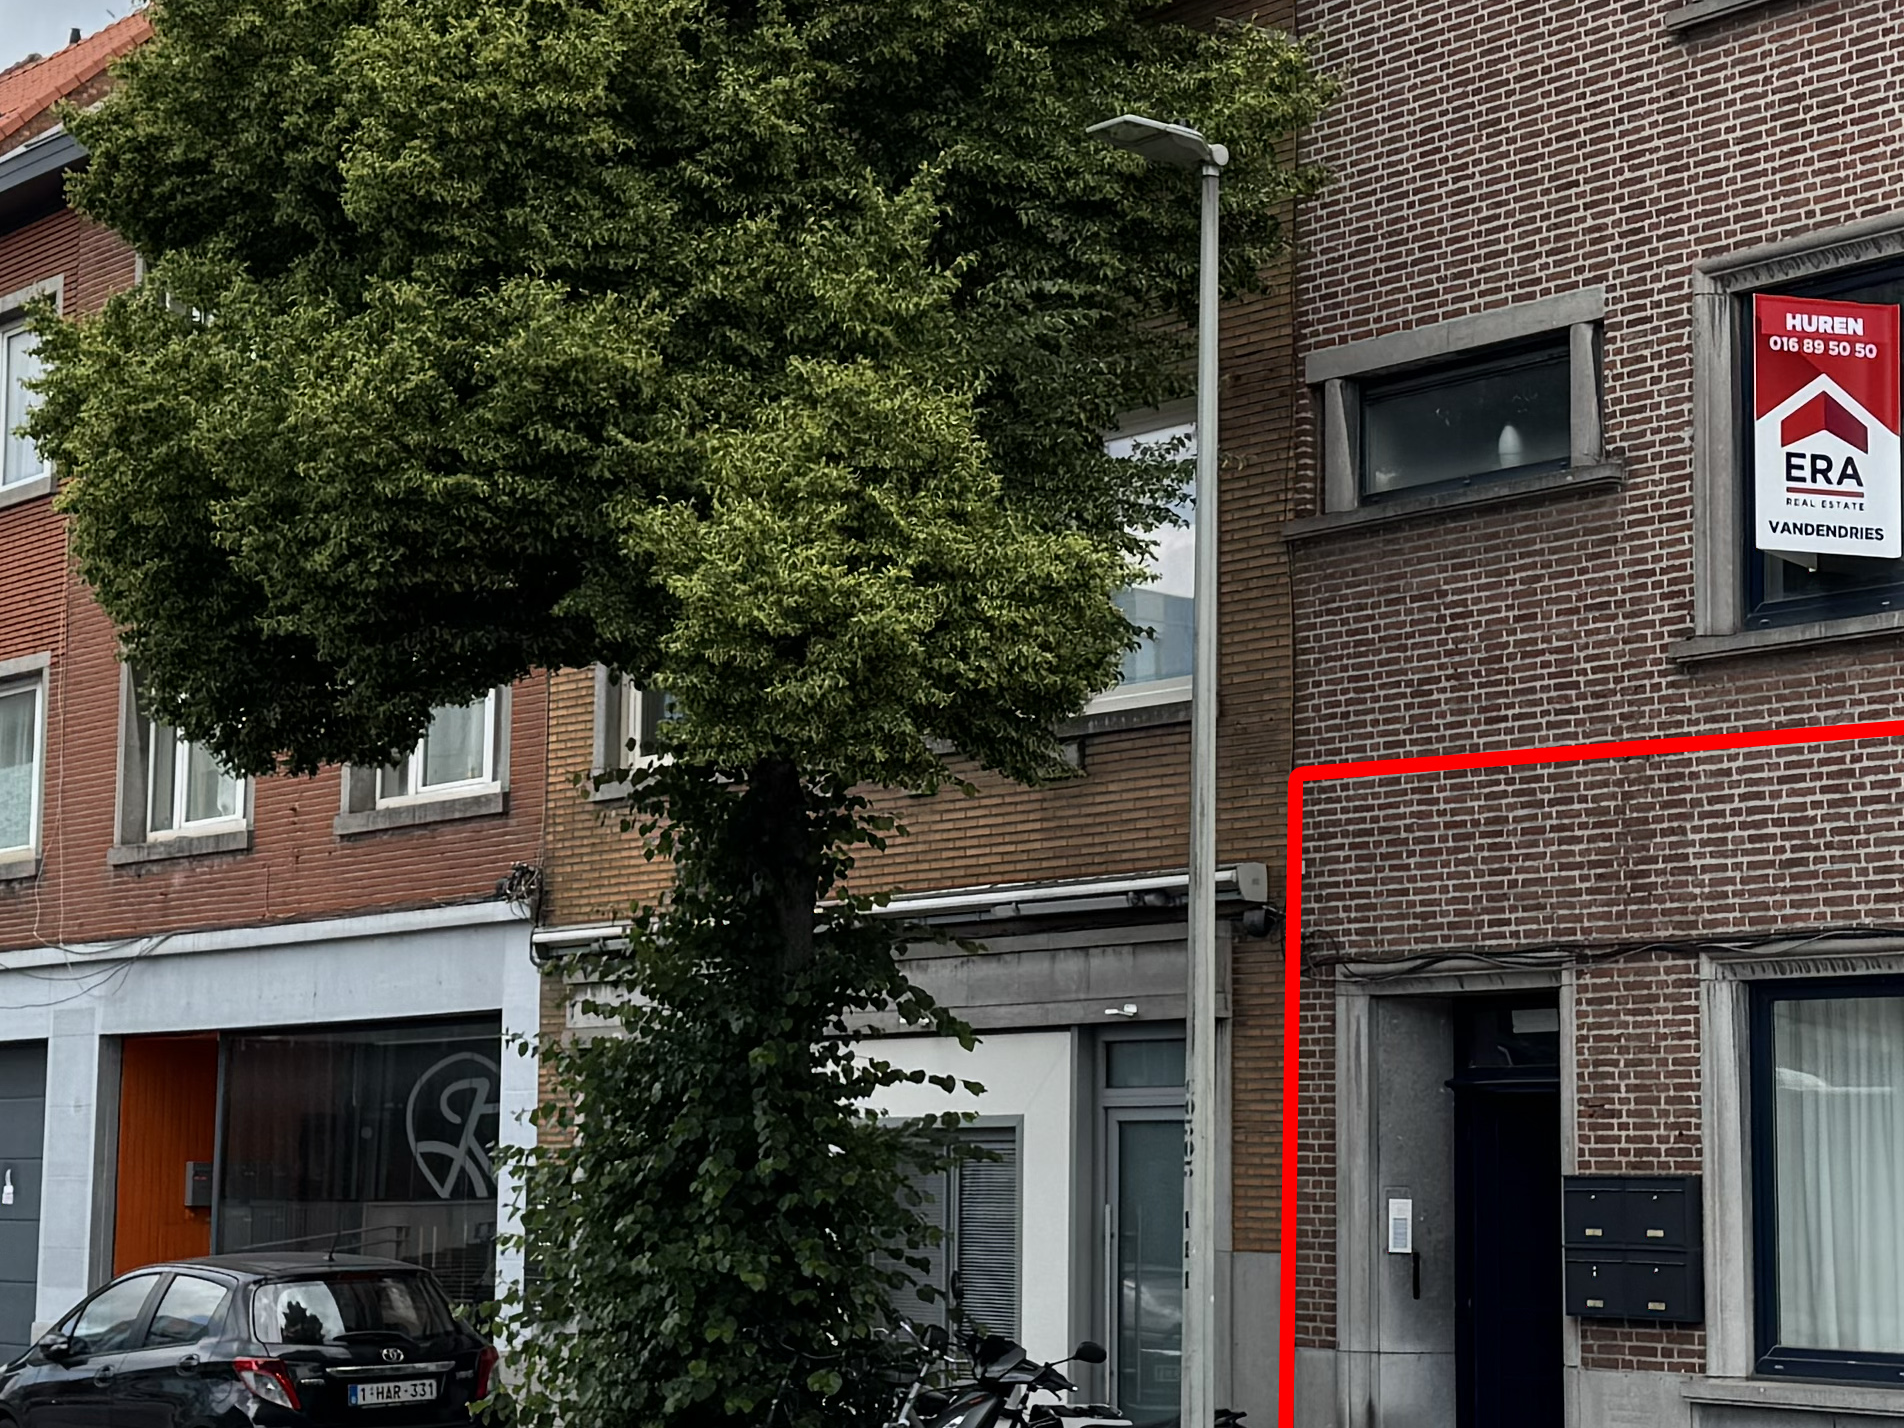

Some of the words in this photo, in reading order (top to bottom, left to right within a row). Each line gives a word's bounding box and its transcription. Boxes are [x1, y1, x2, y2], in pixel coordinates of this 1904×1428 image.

[1786, 312, 1864, 336] HUREN
[1769, 335, 1799, 353] 016
[1803, 337, 1824, 355] 89
[1828, 340, 1851, 357] 50
[1854, 343, 1877, 359] 50
[1785, 451, 1864, 487] ERA
[1786, 497, 1816, 509] REAL
[1821, 500, 1865, 511] ESTATE
[1768, 520, 1884, 542] VANDENDRIES
